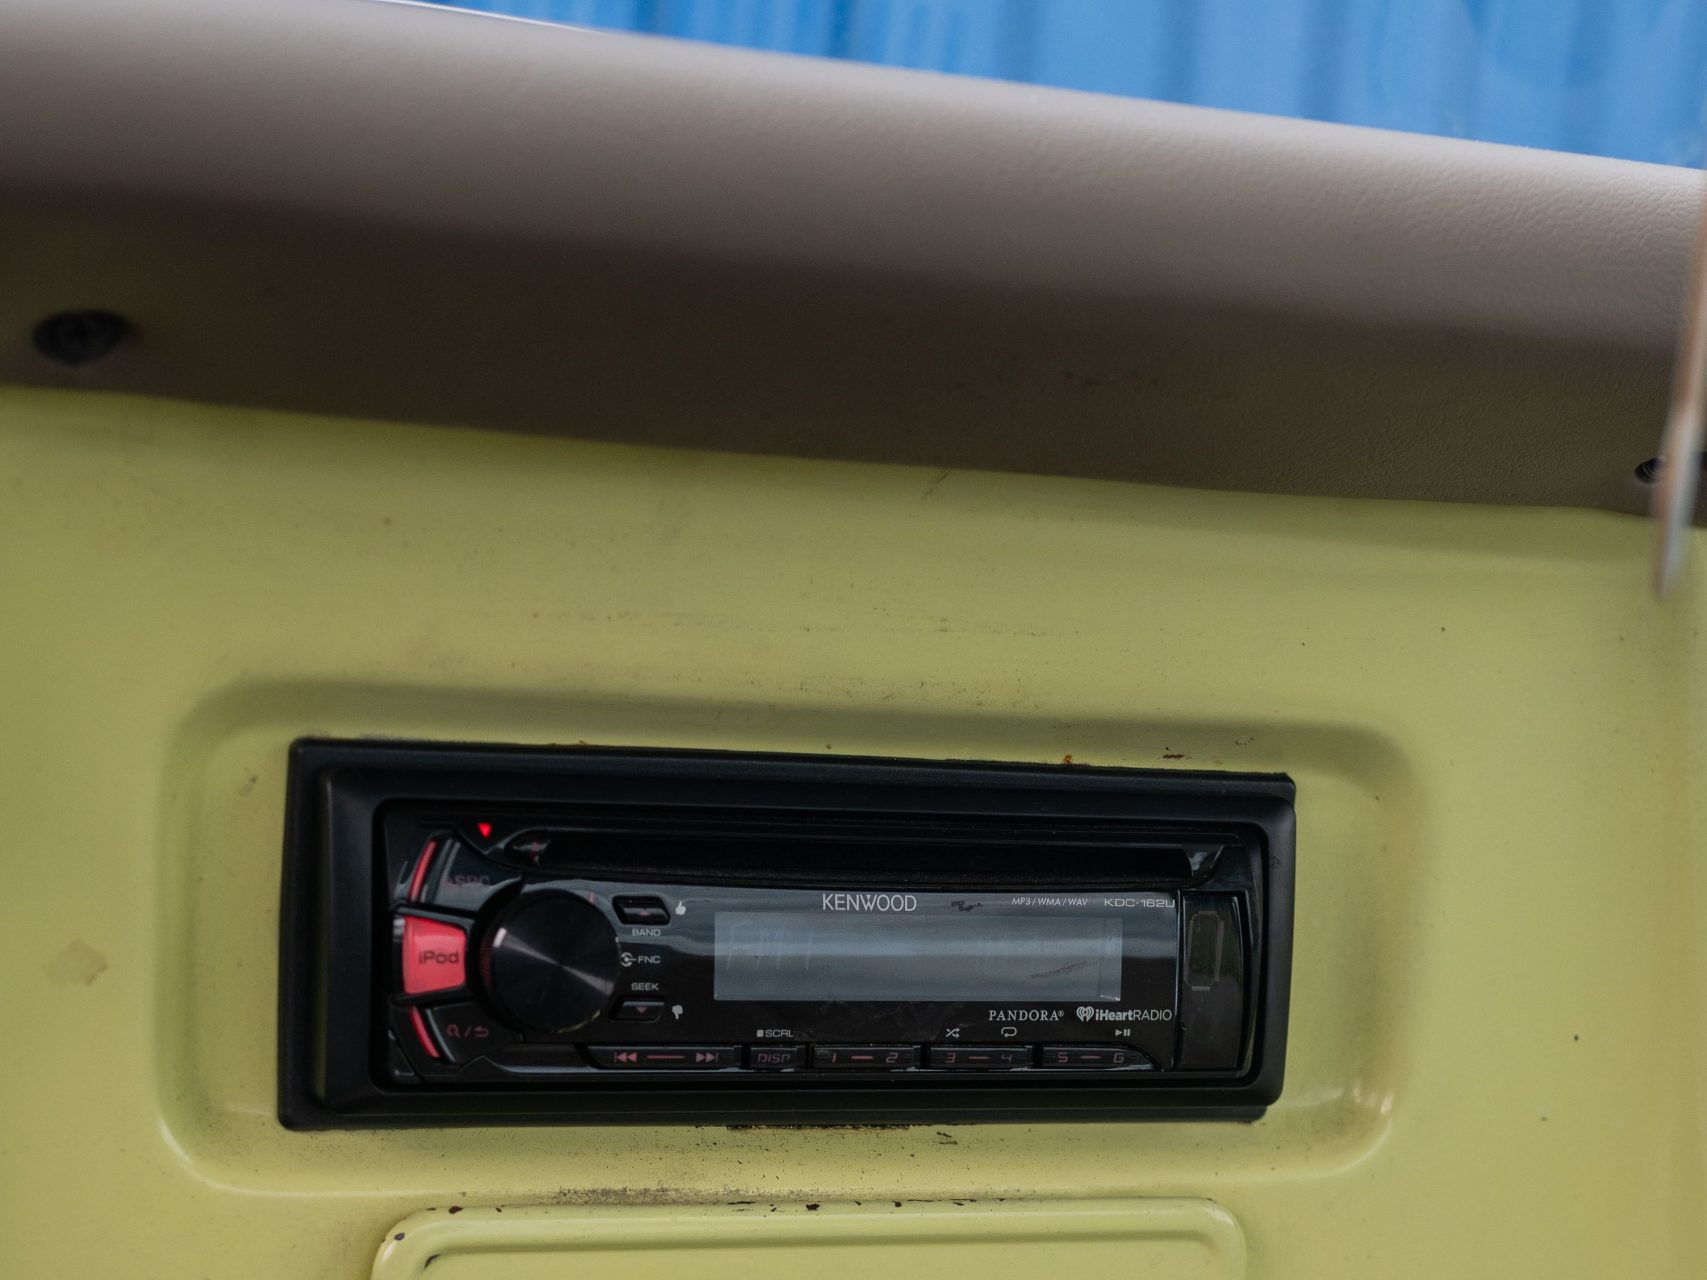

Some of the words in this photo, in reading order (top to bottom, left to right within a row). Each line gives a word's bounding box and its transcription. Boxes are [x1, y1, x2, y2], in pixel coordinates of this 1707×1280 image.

[822, 893, 917, 912] KENWOOD
[1104, 898, 1175, 908] KDC-162U
[631, 927, 661, 937] BAND
[418, 950, 460, 965] iPod
[638, 955, 661, 964] FNC
[631, 982, 660, 991] SEEK
[1095, 1008, 1173, 1021] iHeartRADIO
[765, 1029, 794, 1038] SCRL
[757, 1052, 792, 1064] DISP
[885, 1052, 899, 1063] 2
[945, 1052, 956, 1063] 3
[1001, 1053, 1013, 1063] 4
